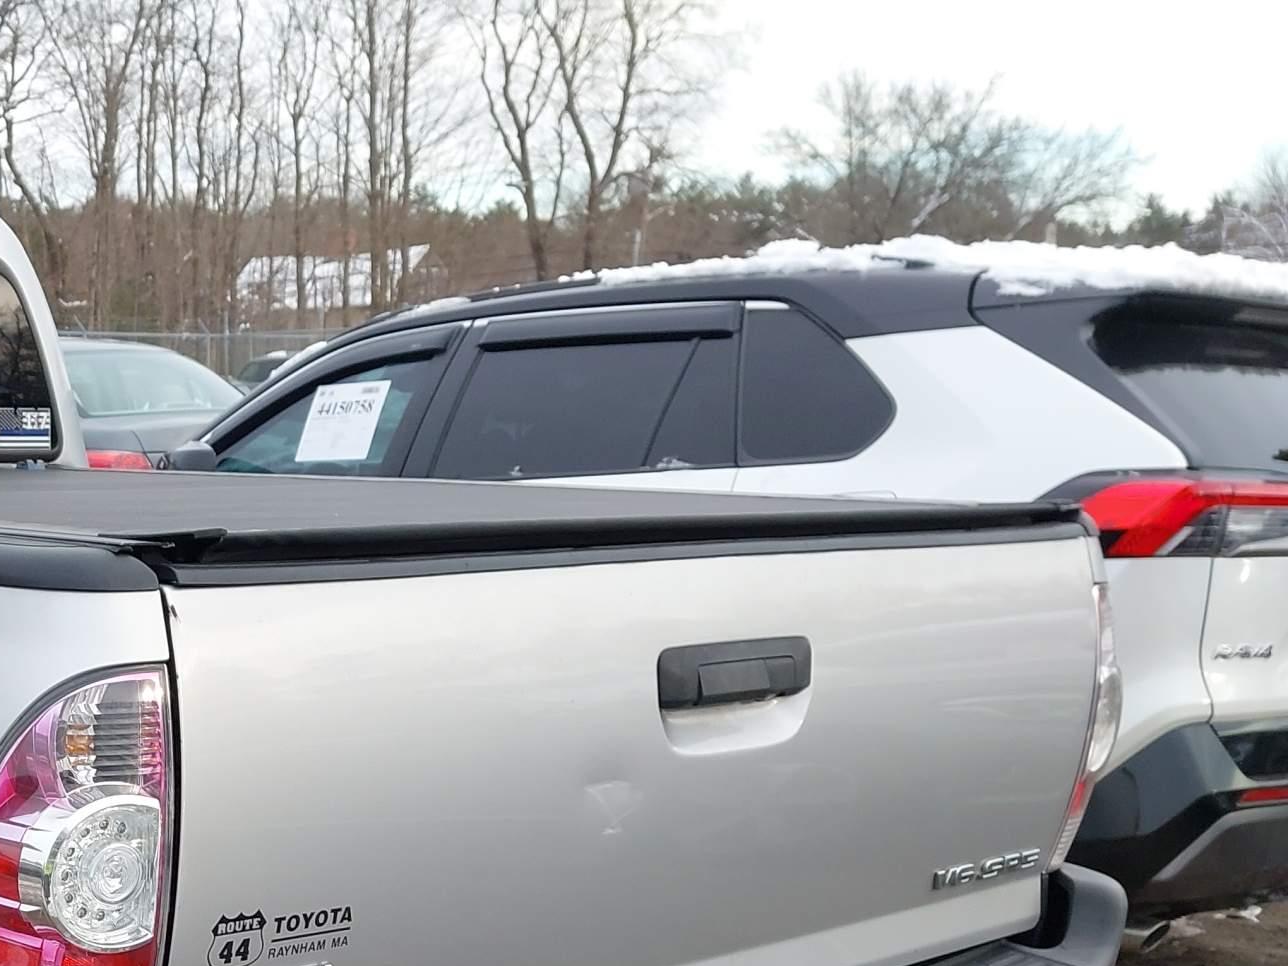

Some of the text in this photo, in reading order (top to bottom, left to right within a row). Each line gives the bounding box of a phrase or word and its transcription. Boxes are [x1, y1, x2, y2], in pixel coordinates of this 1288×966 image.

[216, 917, 262, 935] ROUTE
[273, 905, 353, 934] TOYOTA
[218, 938, 251, 964] 44
[267, 935, 349, 960] RAYNHAM MA
